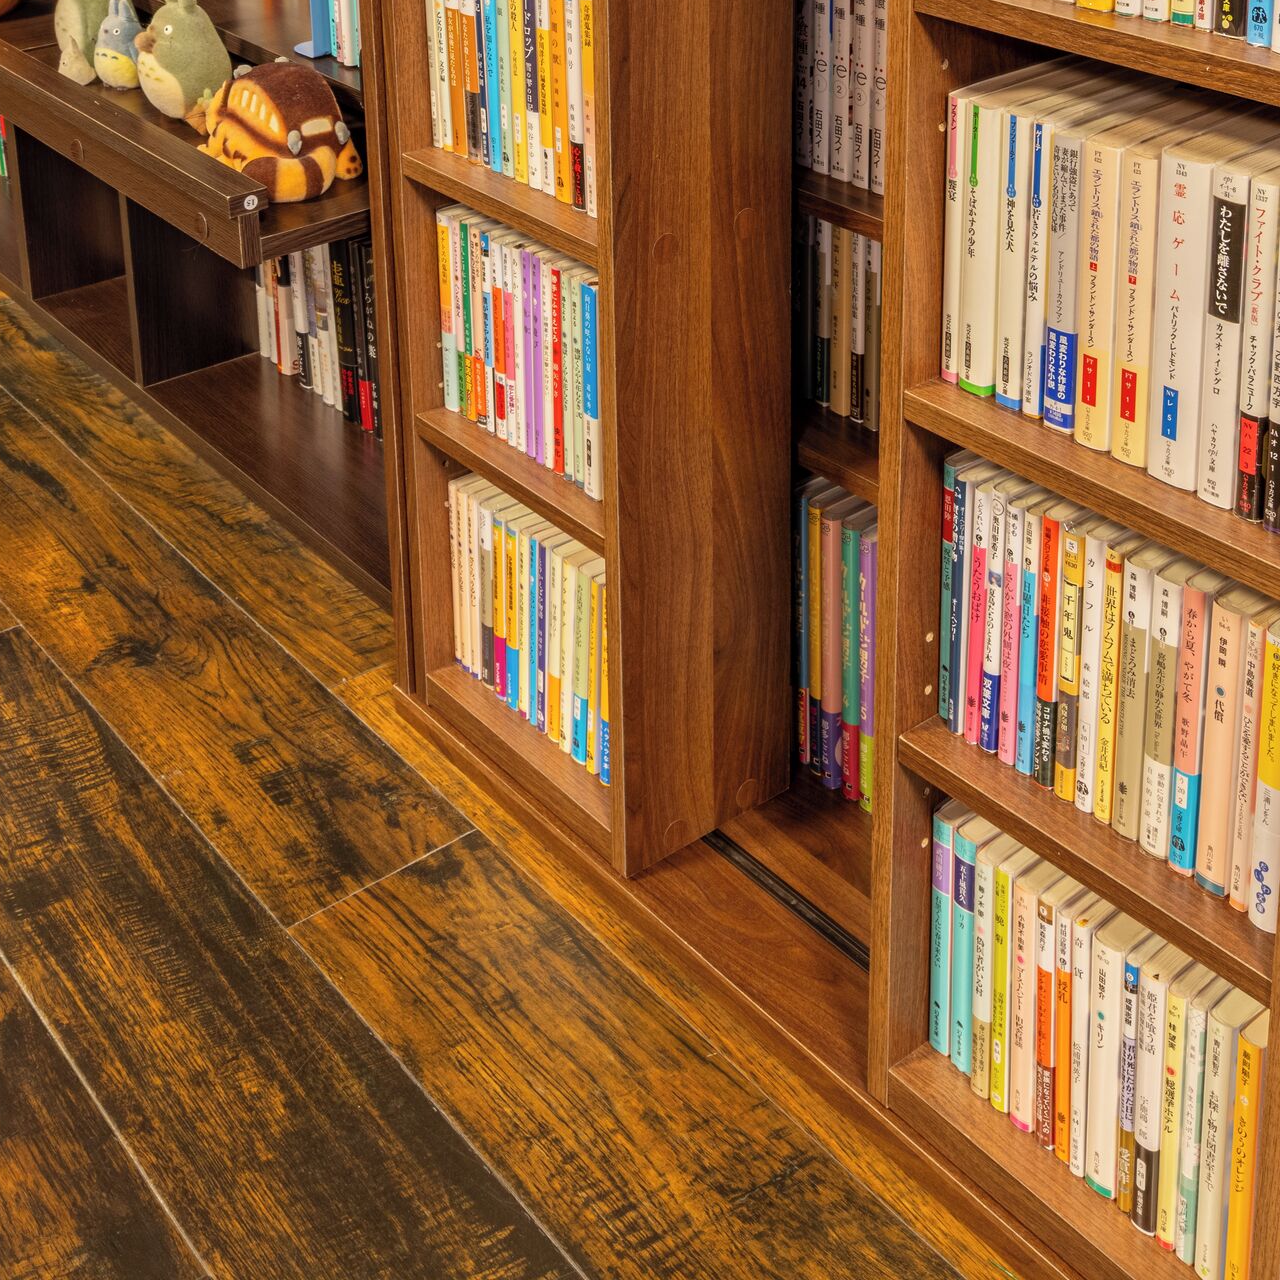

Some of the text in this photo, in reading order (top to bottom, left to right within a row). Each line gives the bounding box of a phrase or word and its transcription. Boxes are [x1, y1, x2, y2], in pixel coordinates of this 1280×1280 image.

[967, 187, 977, 258] そばかすの少年
[1005, 199, 1016, 253] 神を見た犬
[1170, 183, 1186, 301] 霊応ゲーム
[1028, 209, 1042, 302] 若きウェルテルの悩み
[1213, 206, 1232, 395] わたしを離さないで カズオ・イシグロ
[1246, 208, 1266, 410] ファイト・クラブ チャック・パラニューク
[1047, 332, 1056, 390] 風変わりな小説
[1058, 336, 1068, 400] 風変わりな作家の
[971, 558, 981, 622] うたうおばけ
[1063, 595, 1075, 640] 千年鬼
[1085, 558, 1095, 632] カラフル
[1100, 585, 1117, 725] 世界はフムフムで満ちている
[1127, 638, 1136, 700] まどろみ消去
[1180, 608, 1198, 758] 春から夏、やがて冬 歌野晶午
[1214, 699, 1225, 724] 代償
[959, 865, 967, 930] 五十嵐貴久 リカ
[975, 936, 985, 998] 偽医者がいる村
[1017, 915, 1026, 955] 小野不由美
[1058, 979, 1068, 1004] 授乳
[1098, 969, 1107, 1000] 山田悠介
[1145, 991, 1158, 1056] 姫君を喰う話
[1163, 1077, 1177, 1134] 総選挙ホテル
[1206, 1091, 1219, 1192] お探し物は図書室まで
[1235, 1116, 1247, 1193] きのうのオレンジ
